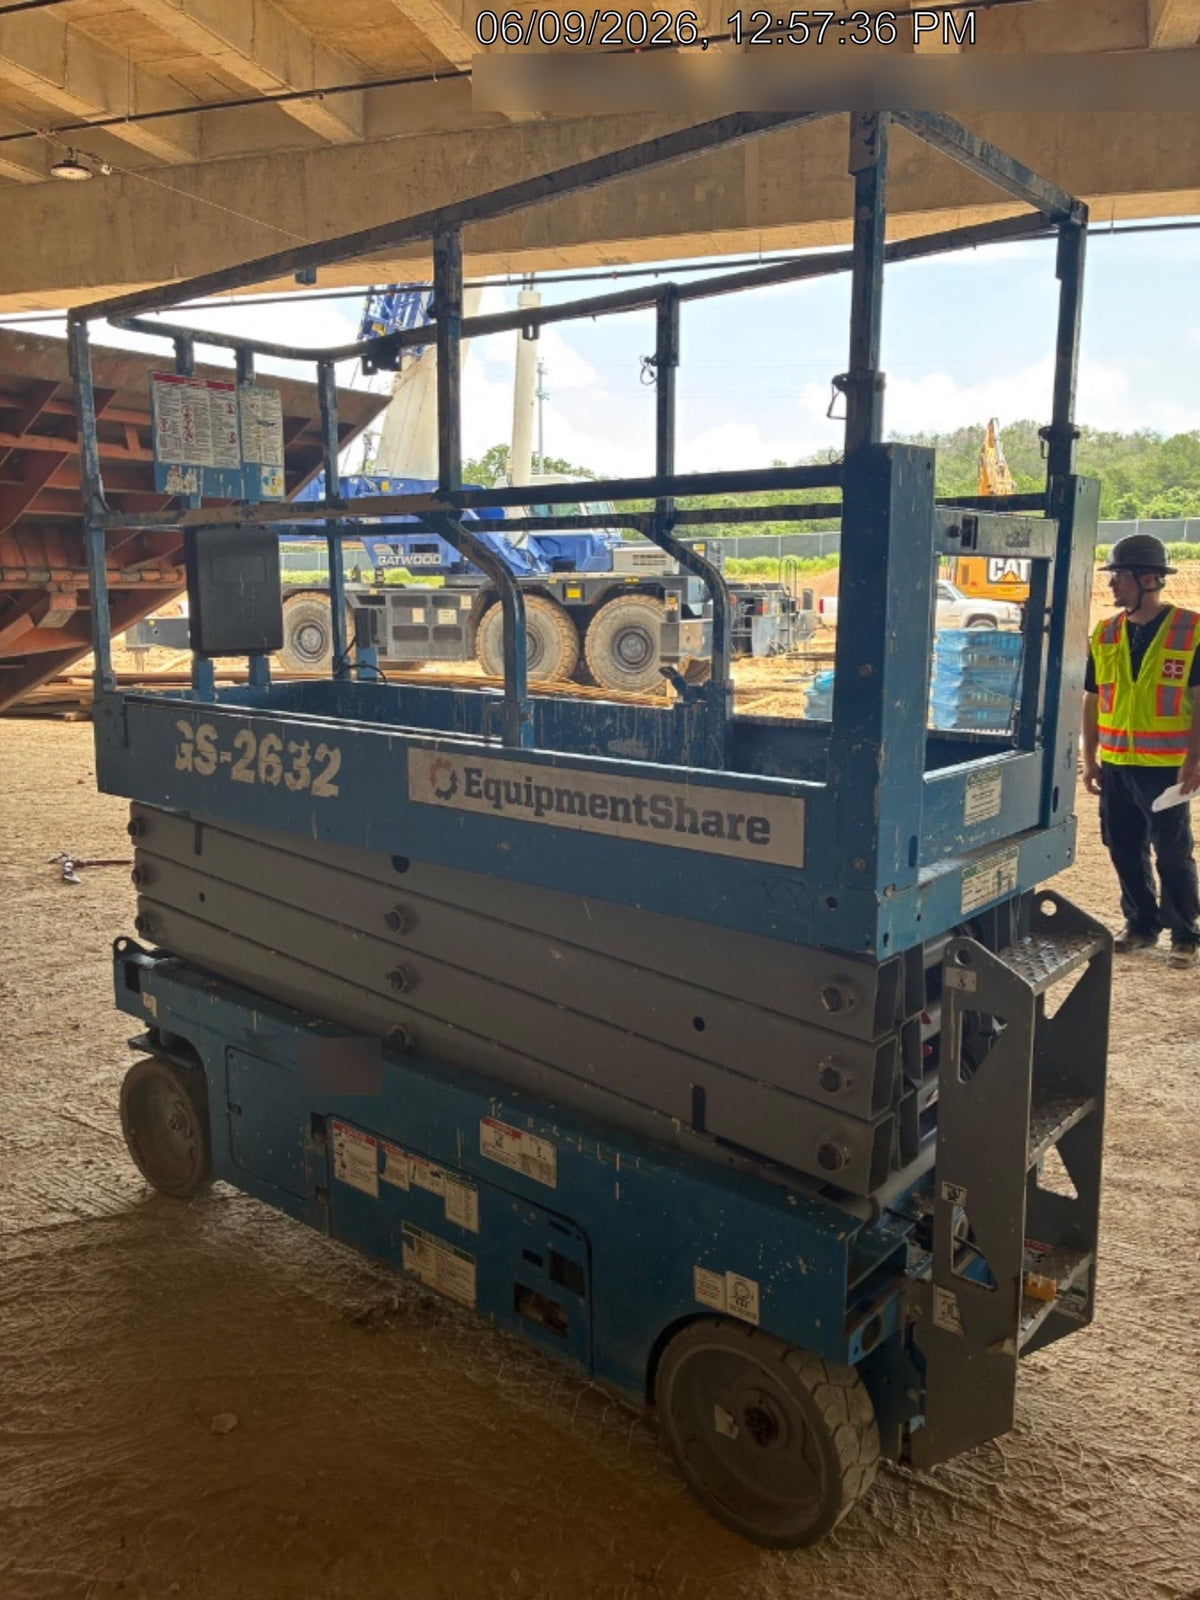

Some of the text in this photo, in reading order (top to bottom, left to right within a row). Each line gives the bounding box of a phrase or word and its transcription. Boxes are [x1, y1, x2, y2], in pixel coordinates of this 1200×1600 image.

[377, 554, 442, 566] GATWOOD
[988, 558, 1032, 582] CAT
[175, 719, 342, 797] GS-2632
[463, 766, 771, 845] EquipmentShare
